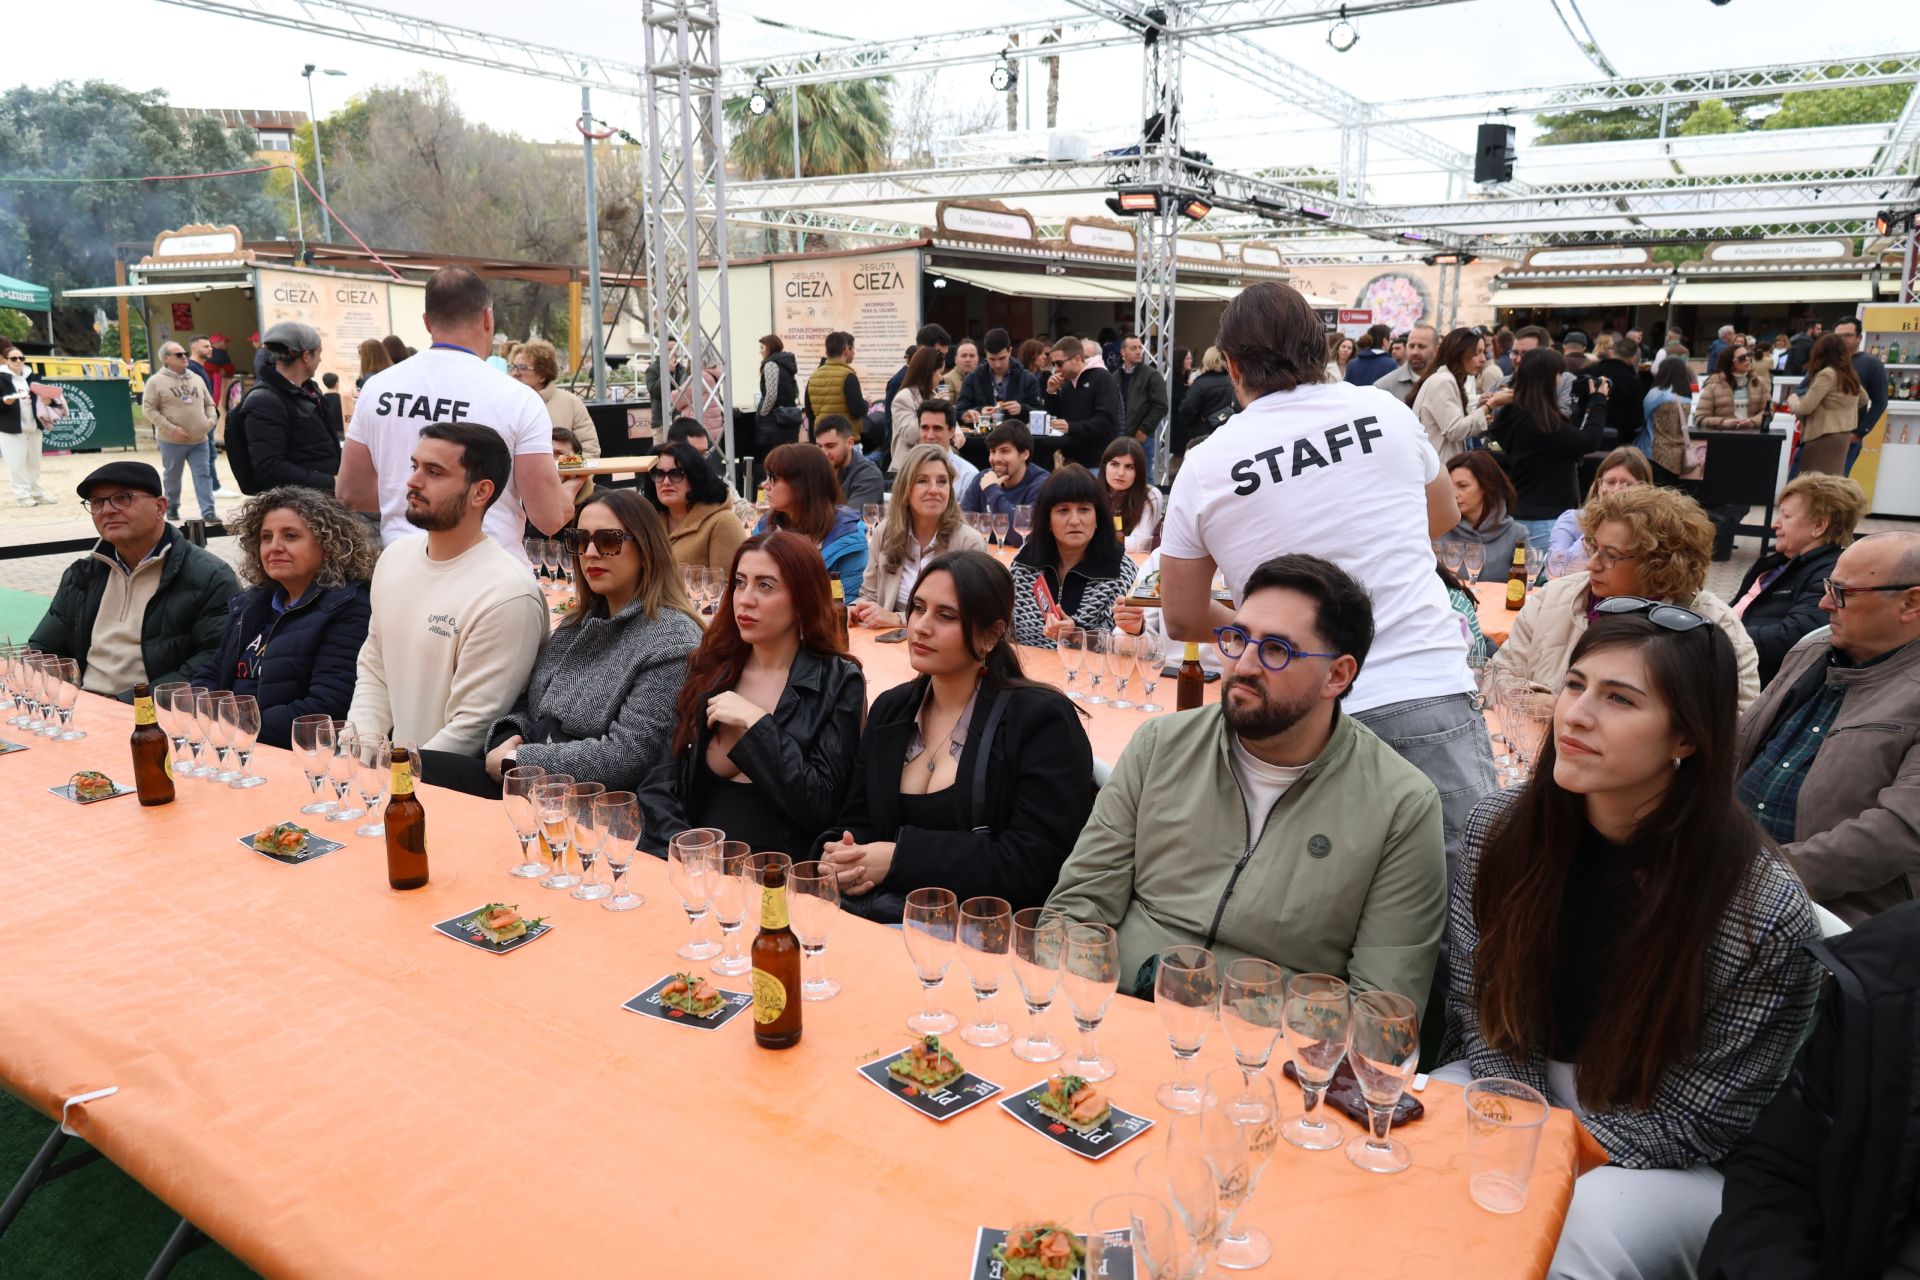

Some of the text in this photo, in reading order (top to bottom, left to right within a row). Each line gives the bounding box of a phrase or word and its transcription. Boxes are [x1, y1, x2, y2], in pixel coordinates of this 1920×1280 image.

[853, 271, 904, 290] CIEZA
[274, 288, 319, 304] CIEZA
[336, 289, 378, 305] CIEZA
[786, 281, 833, 297] CIEZA
[169, 384, 199, 399] USA
[375, 391, 471, 423] STAFF
[1230, 415, 1383, 497] STAFF
